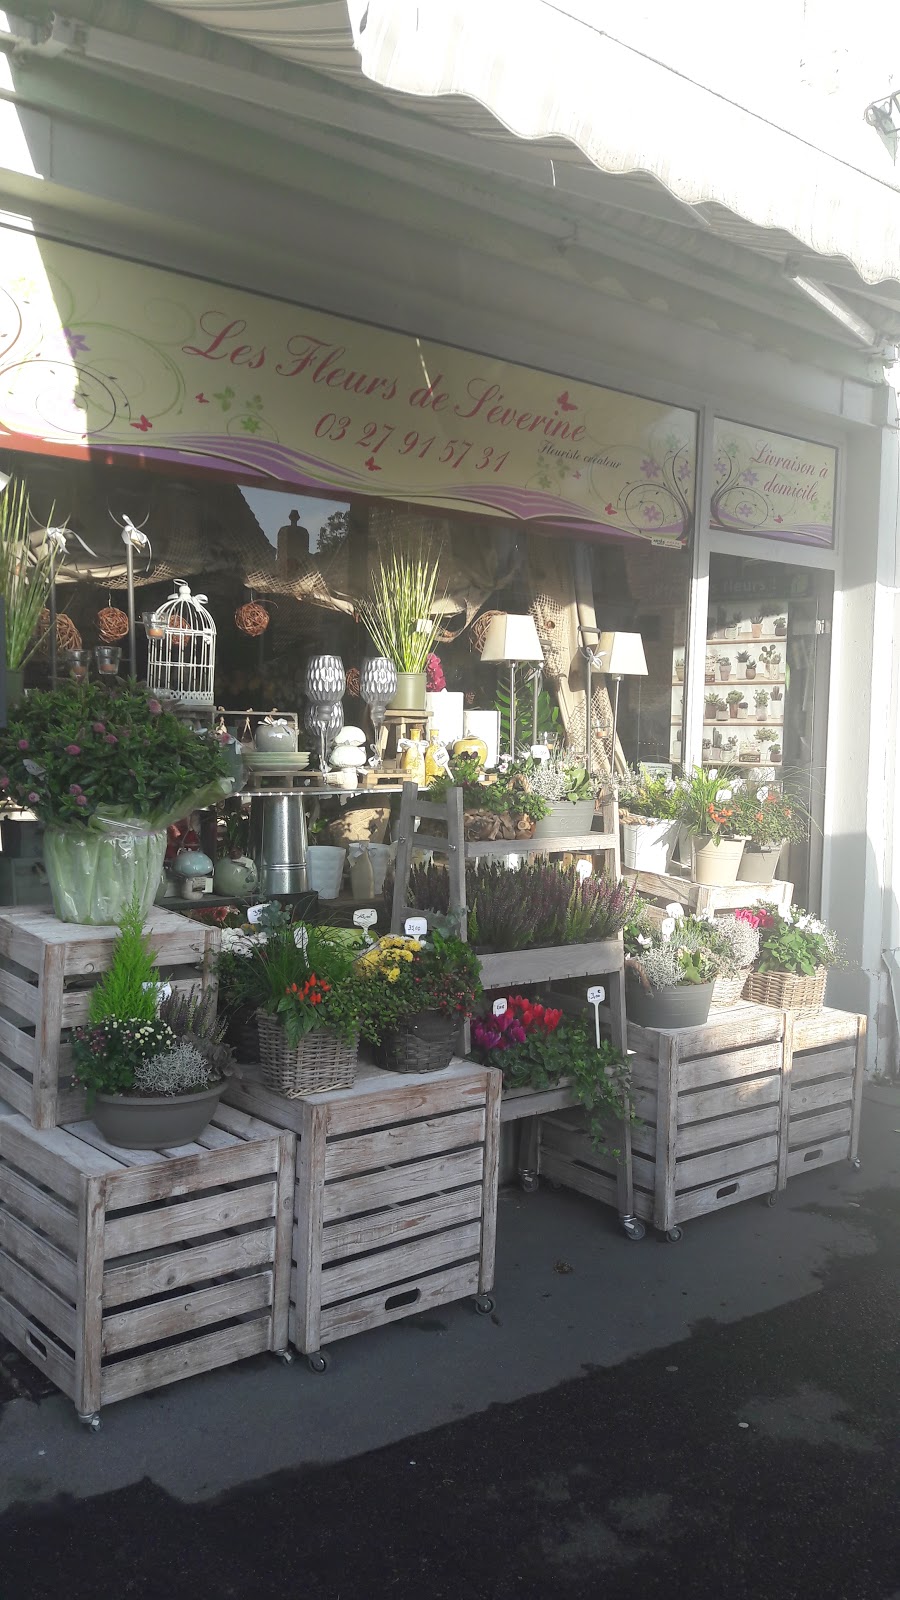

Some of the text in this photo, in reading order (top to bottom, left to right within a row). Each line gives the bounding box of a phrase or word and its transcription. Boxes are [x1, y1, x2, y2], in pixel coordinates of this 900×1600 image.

[181, 311, 587, 442] Les Fleurs de Séverine
[314, 413, 511, 473] 03 27 91 57 31
[538, 440, 580, 460] Fleuriste
[749, 440, 829, 479] Livraison à
[763, 473, 819, 502] domicile
